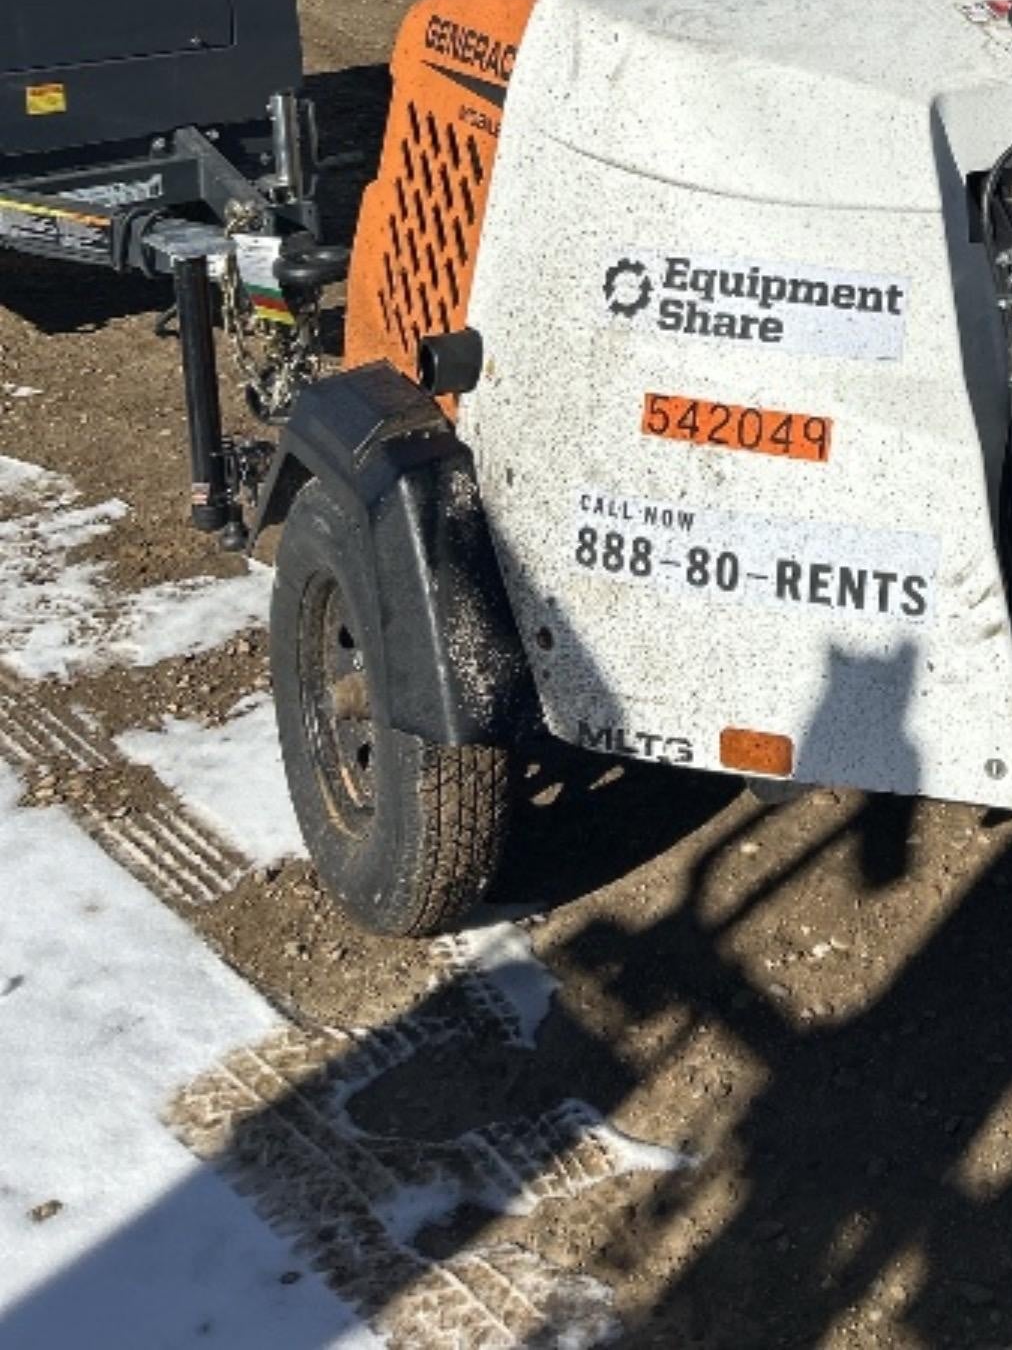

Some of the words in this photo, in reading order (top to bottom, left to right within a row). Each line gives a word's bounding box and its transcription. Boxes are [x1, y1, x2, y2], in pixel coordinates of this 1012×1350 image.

[663, 257, 903, 316] Equipment
[657, 299, 783, 343] Share
[648, 395, 827, 459] 542049
[579, 494, 633, 521] CALL
[643, 506, 695, 532] NOW
[575, 525, 928, 617] 888-80-RENTS
